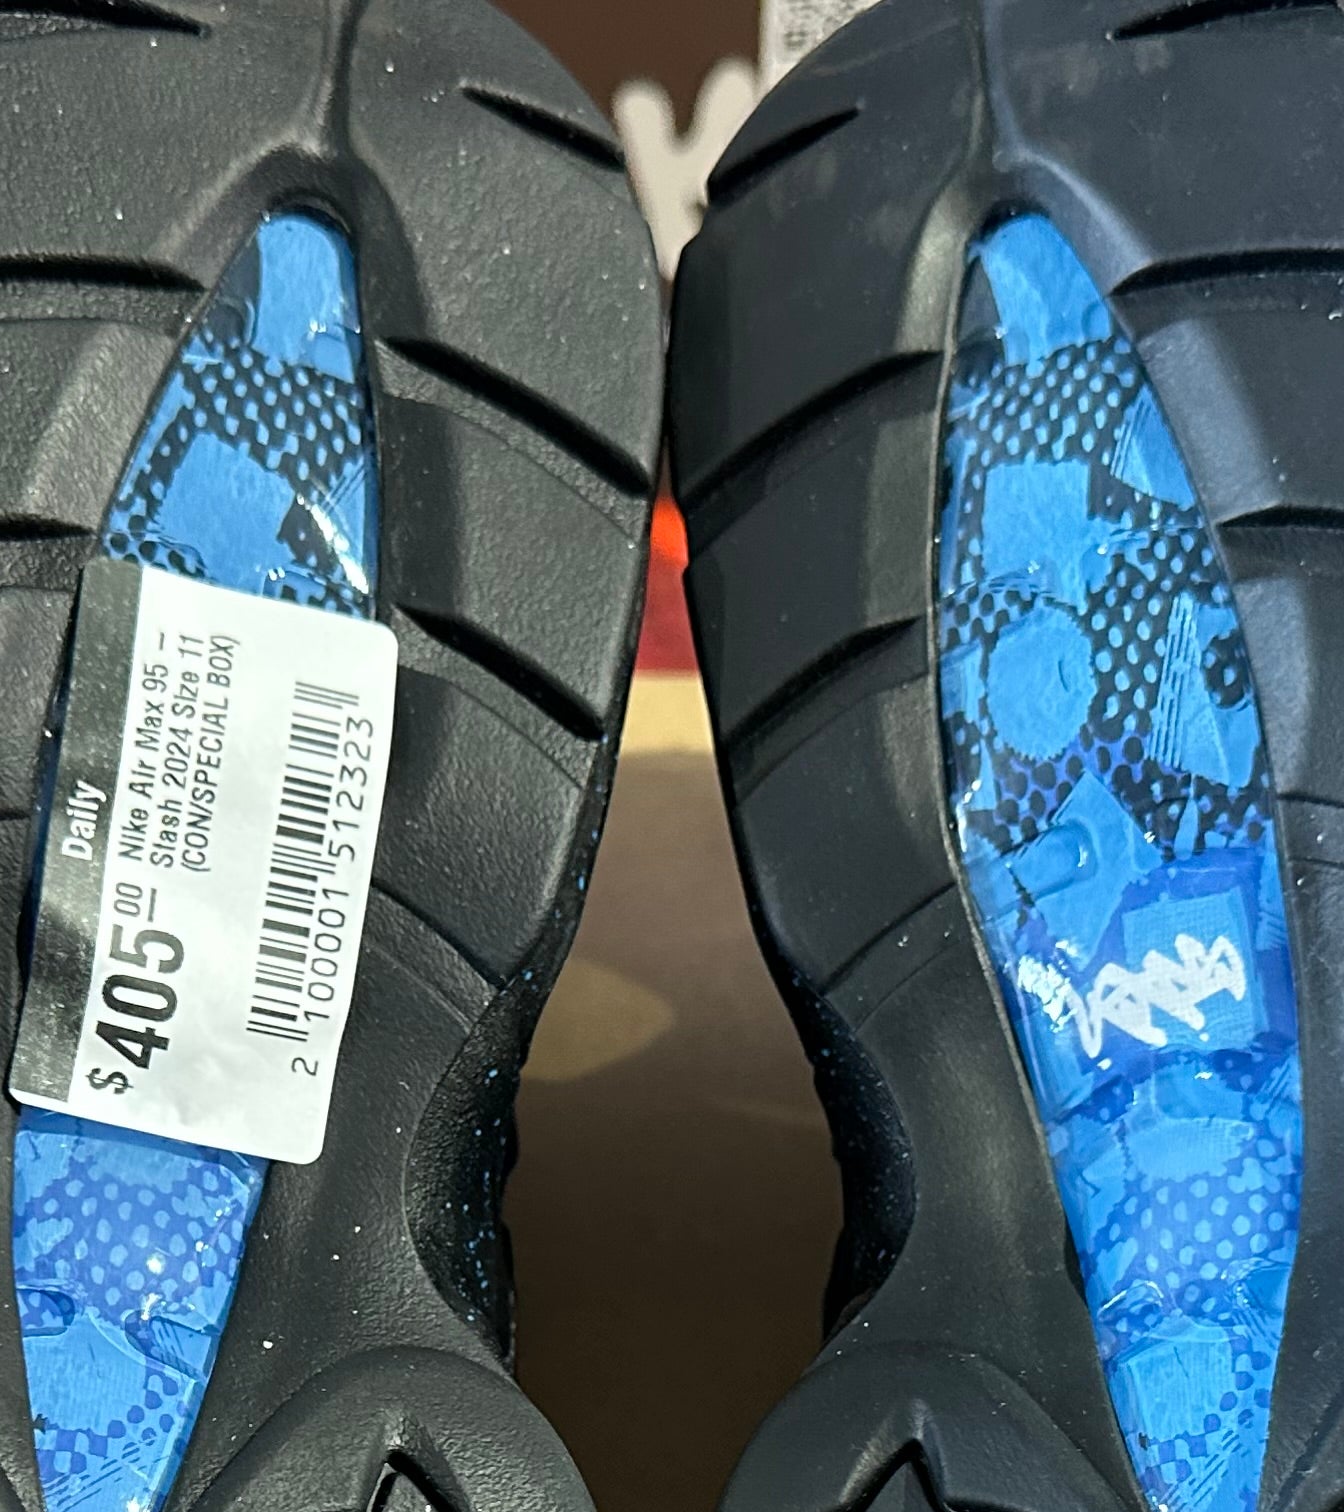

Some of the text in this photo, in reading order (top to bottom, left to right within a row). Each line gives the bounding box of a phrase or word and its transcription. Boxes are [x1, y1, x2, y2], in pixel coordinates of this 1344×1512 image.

[142, 664, 168, 693] 95
[134, 700, 165, 752] Max
[150, 635, 204, 868] Stash 2024 Size 11
[181, 636, 241, 872] (CON/SPECIAL BOX)
[129, 760, 156, 799] Air
[61, 780, 107, 861] Daily
[118, 808, 149, 861] Nike
[304, 888, 349, 1023] 100001
[328, 716, 373, 862] 512323
